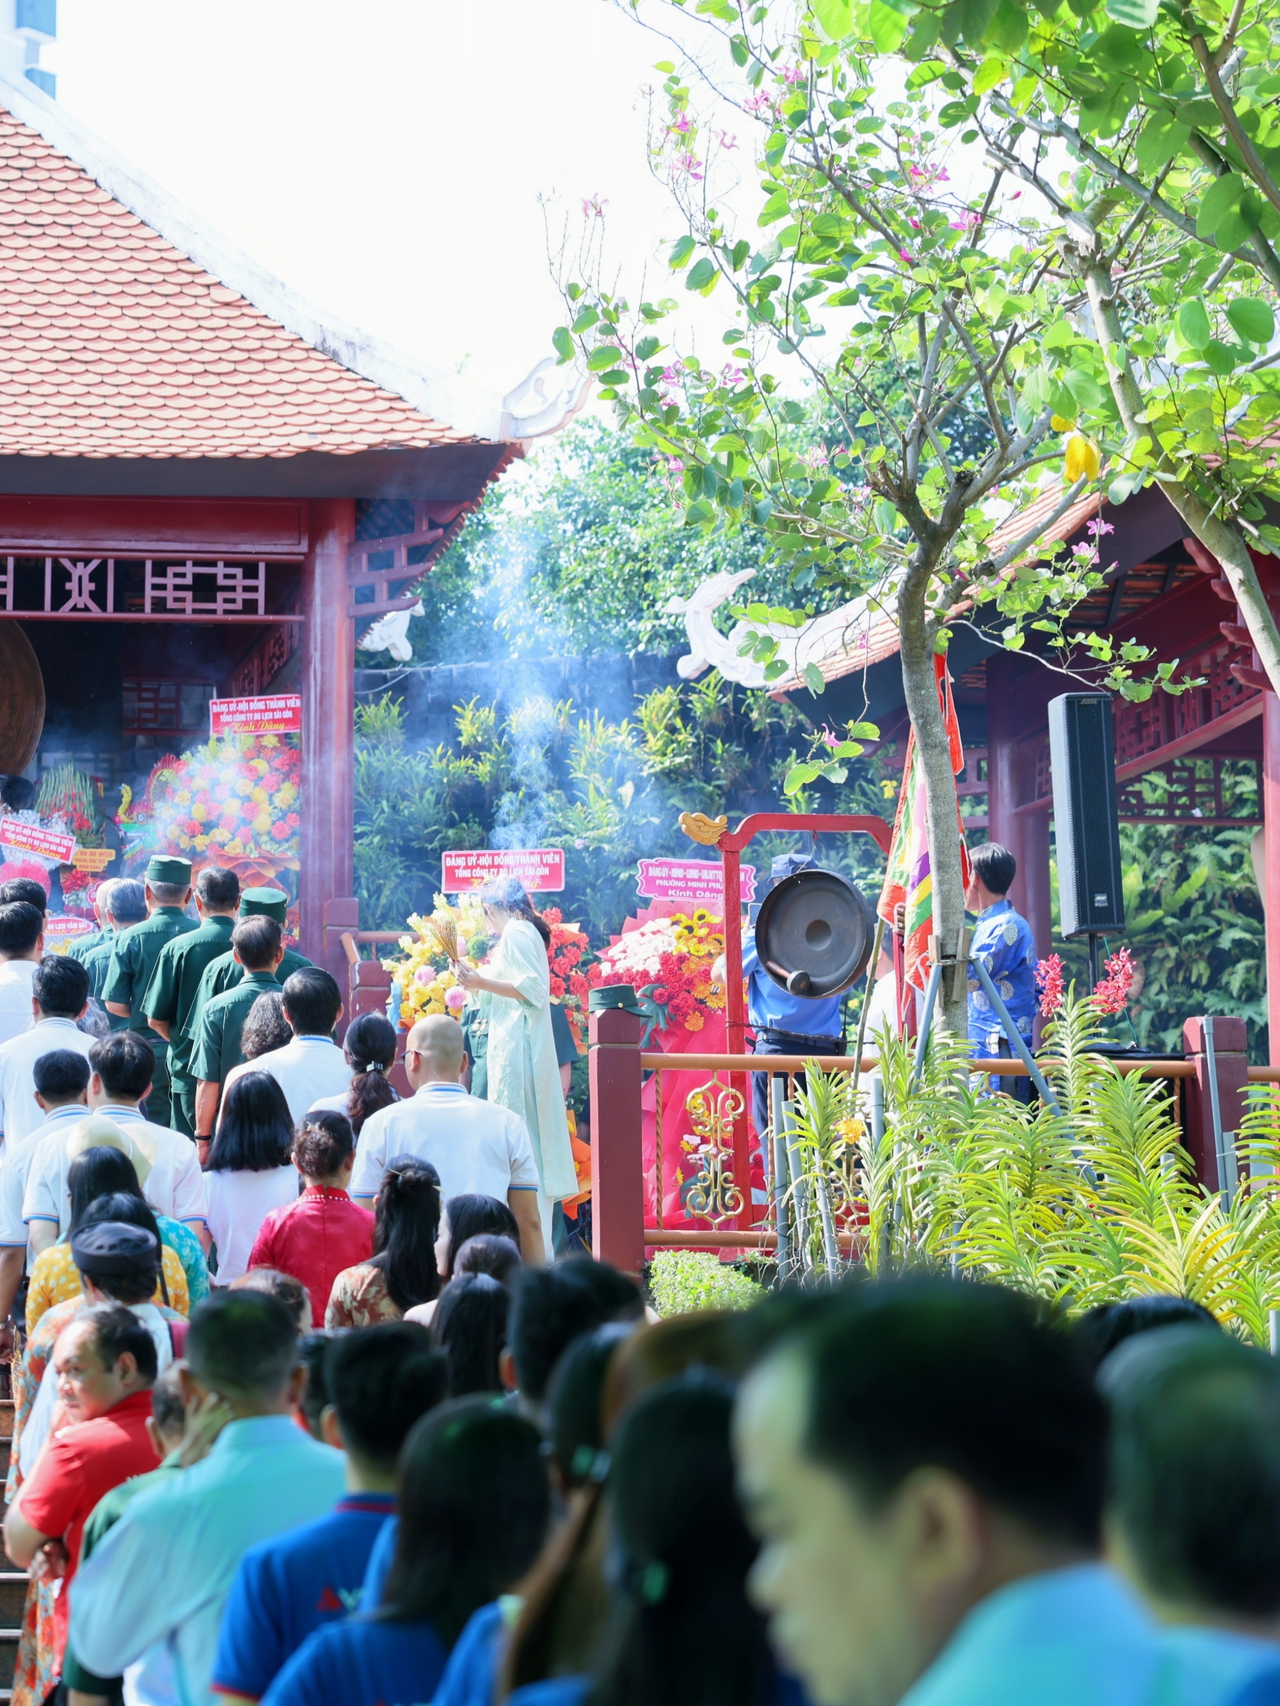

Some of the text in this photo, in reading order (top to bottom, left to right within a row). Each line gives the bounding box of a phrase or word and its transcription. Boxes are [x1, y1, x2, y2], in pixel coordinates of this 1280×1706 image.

[213, 701, 228, 713] ĐẢNG
[249, 698, 266, 711] ĐỒNG
[266, 698, 286, 710] THÀNH
[287, 696, 301, 708] VIÊN
[220, 708, 293, 723] TỔNG CÔNG TY DU LỊCH SÀI GÒN
[446, 853, 466, 867] ĐẢNG
[494, 852, 515, 866] ĐỒNG
[516, 852, 540, 865] THÀNH
[542, 851, 560, 864] VIÊN
[455, 866, 472, 878] TỔNG
[473, 867, 489, 878] CÔNG
[525, 865, 535, 876] SÀI
[536, 864, 550, 876] GÒN
[656, 879, 724, 891] PHƯỜNG MINH PHỤ
[668, 888, 693, 898] Kính
